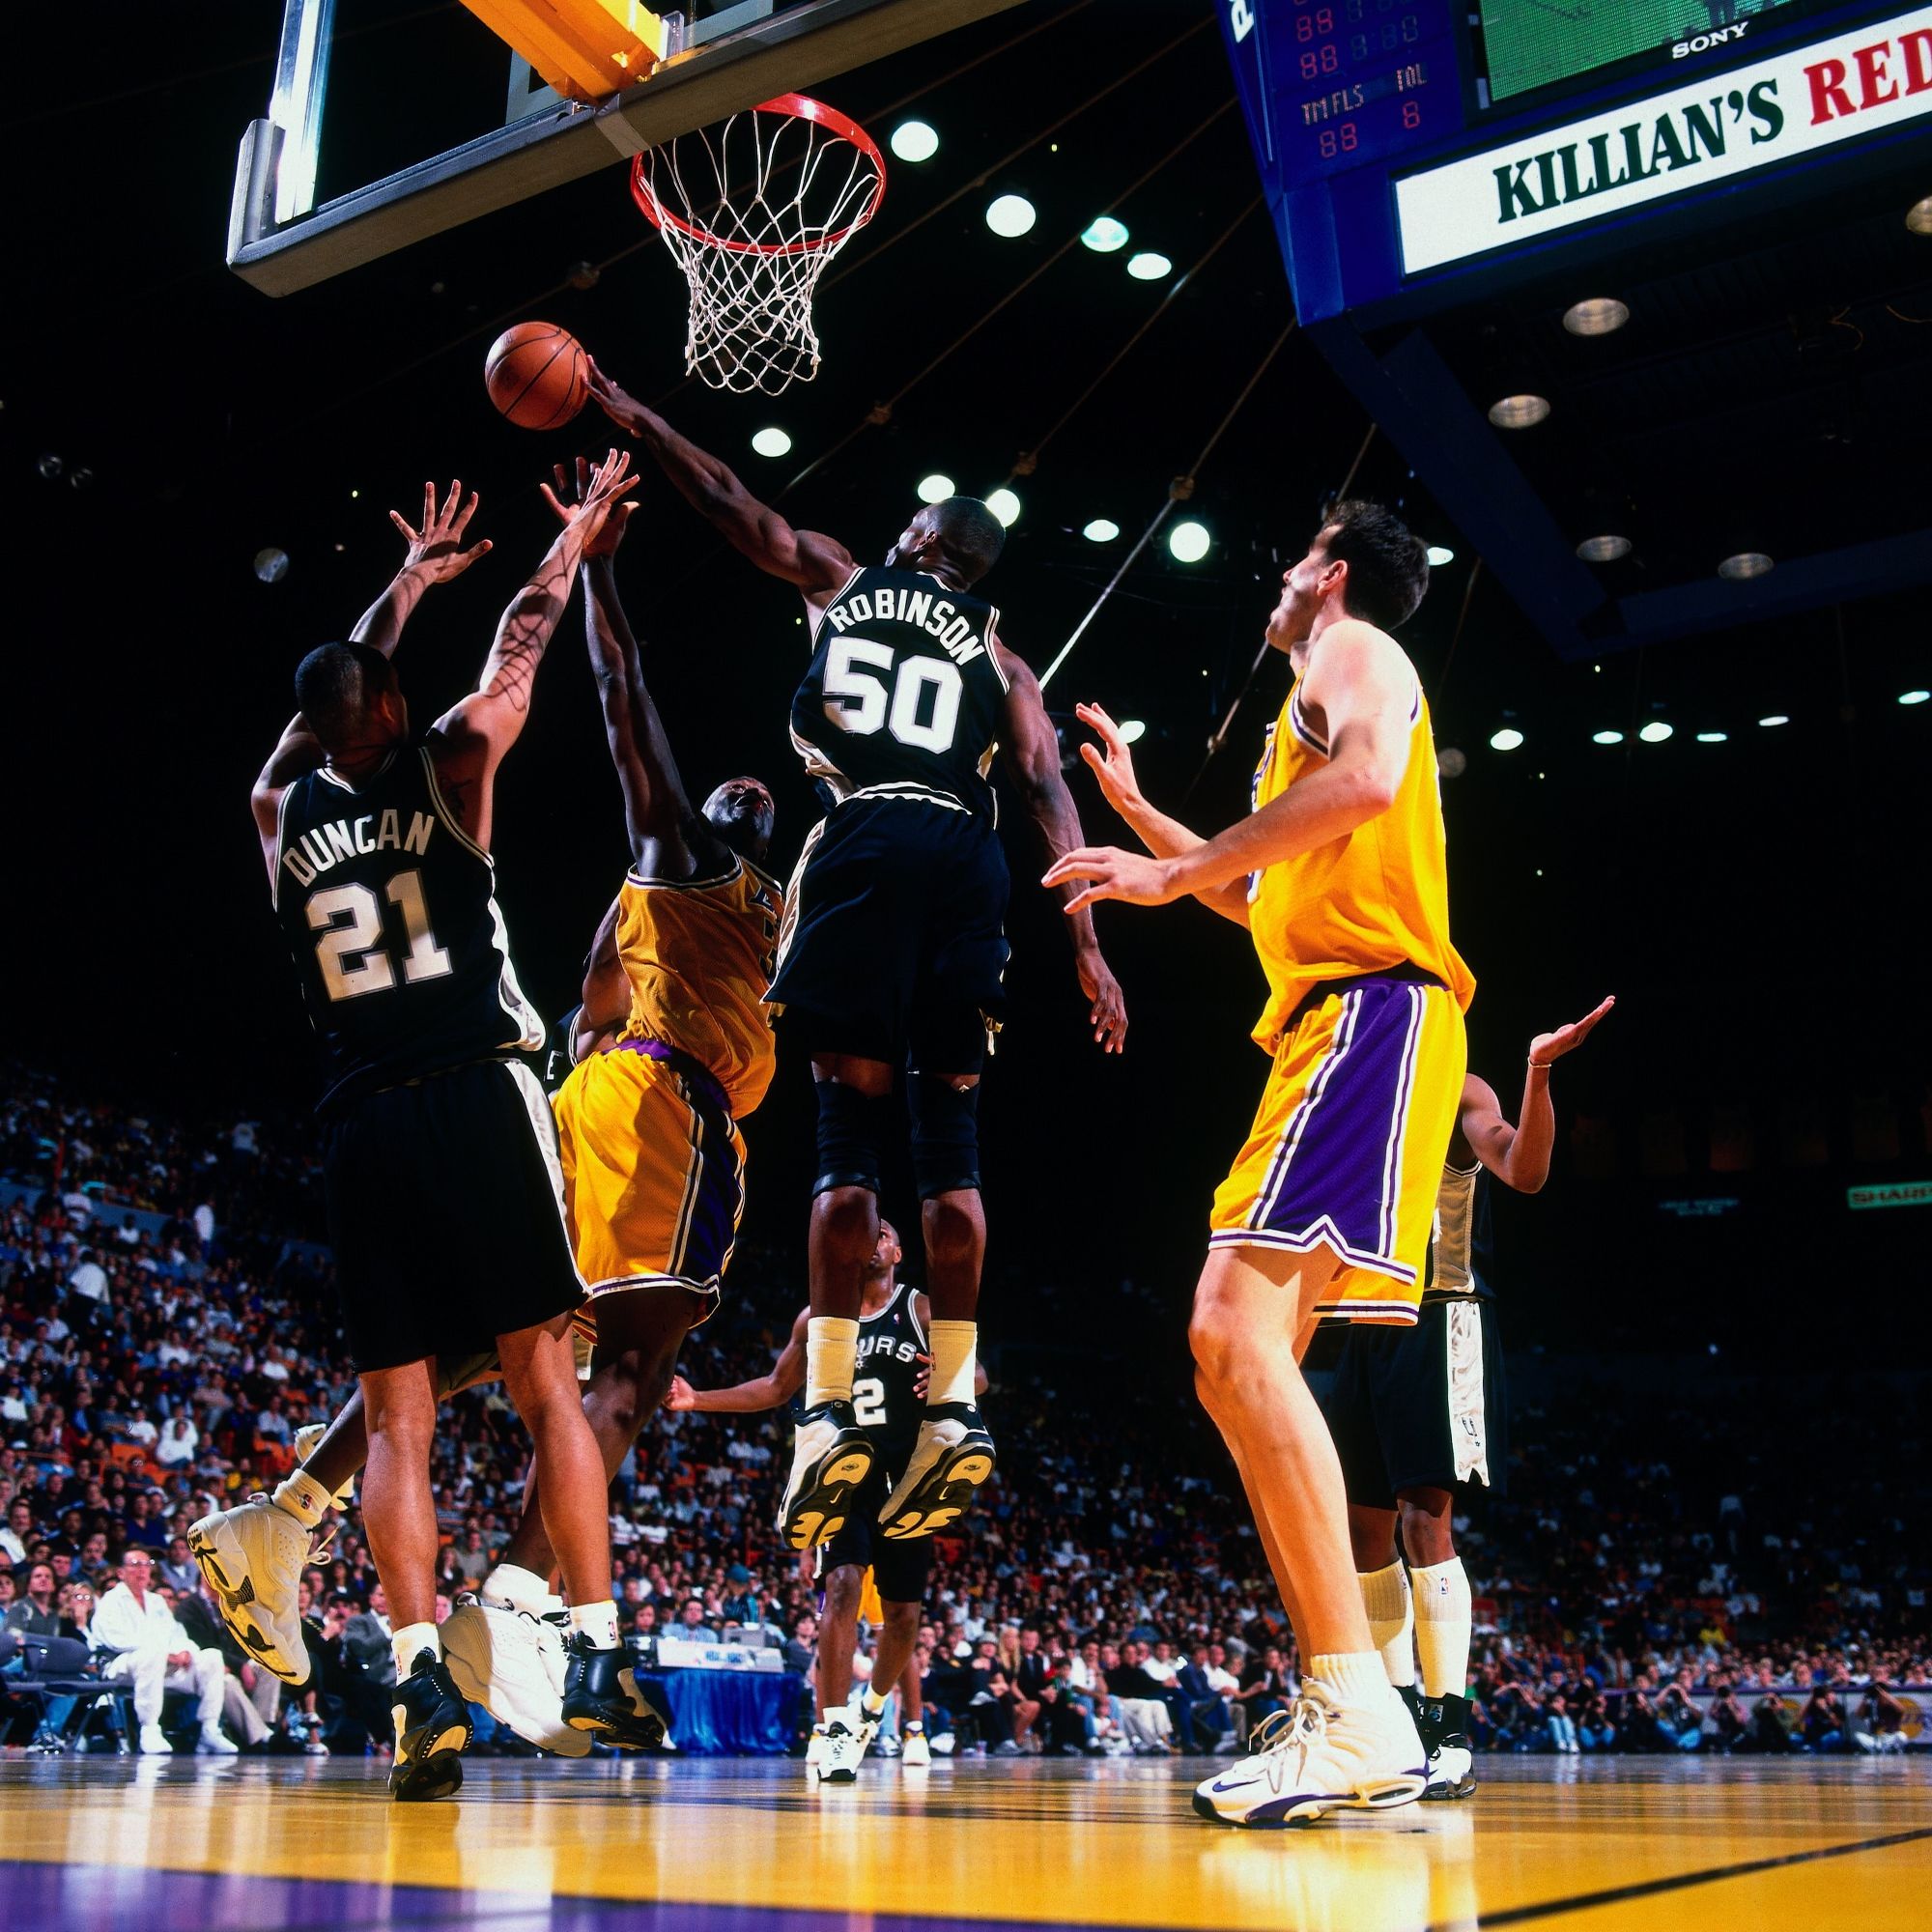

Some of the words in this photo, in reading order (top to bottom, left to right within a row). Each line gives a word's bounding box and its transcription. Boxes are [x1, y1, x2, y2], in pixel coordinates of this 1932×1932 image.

[1671, 21, 1748, 60] SONY
[1492, 78, 1784, 224] KILLIAN'S
[1803, 29, 1932, 126] RED
[827, 588, 986, 667] ROBINSON
[821, 637, 964, 754] 50
[282, 809, 435, 887] DUNCAN
[304, 868, 454, 1002] 21
[859, 1336, 918, 1363] URS
[852, 1378, 887, 1427] 2
